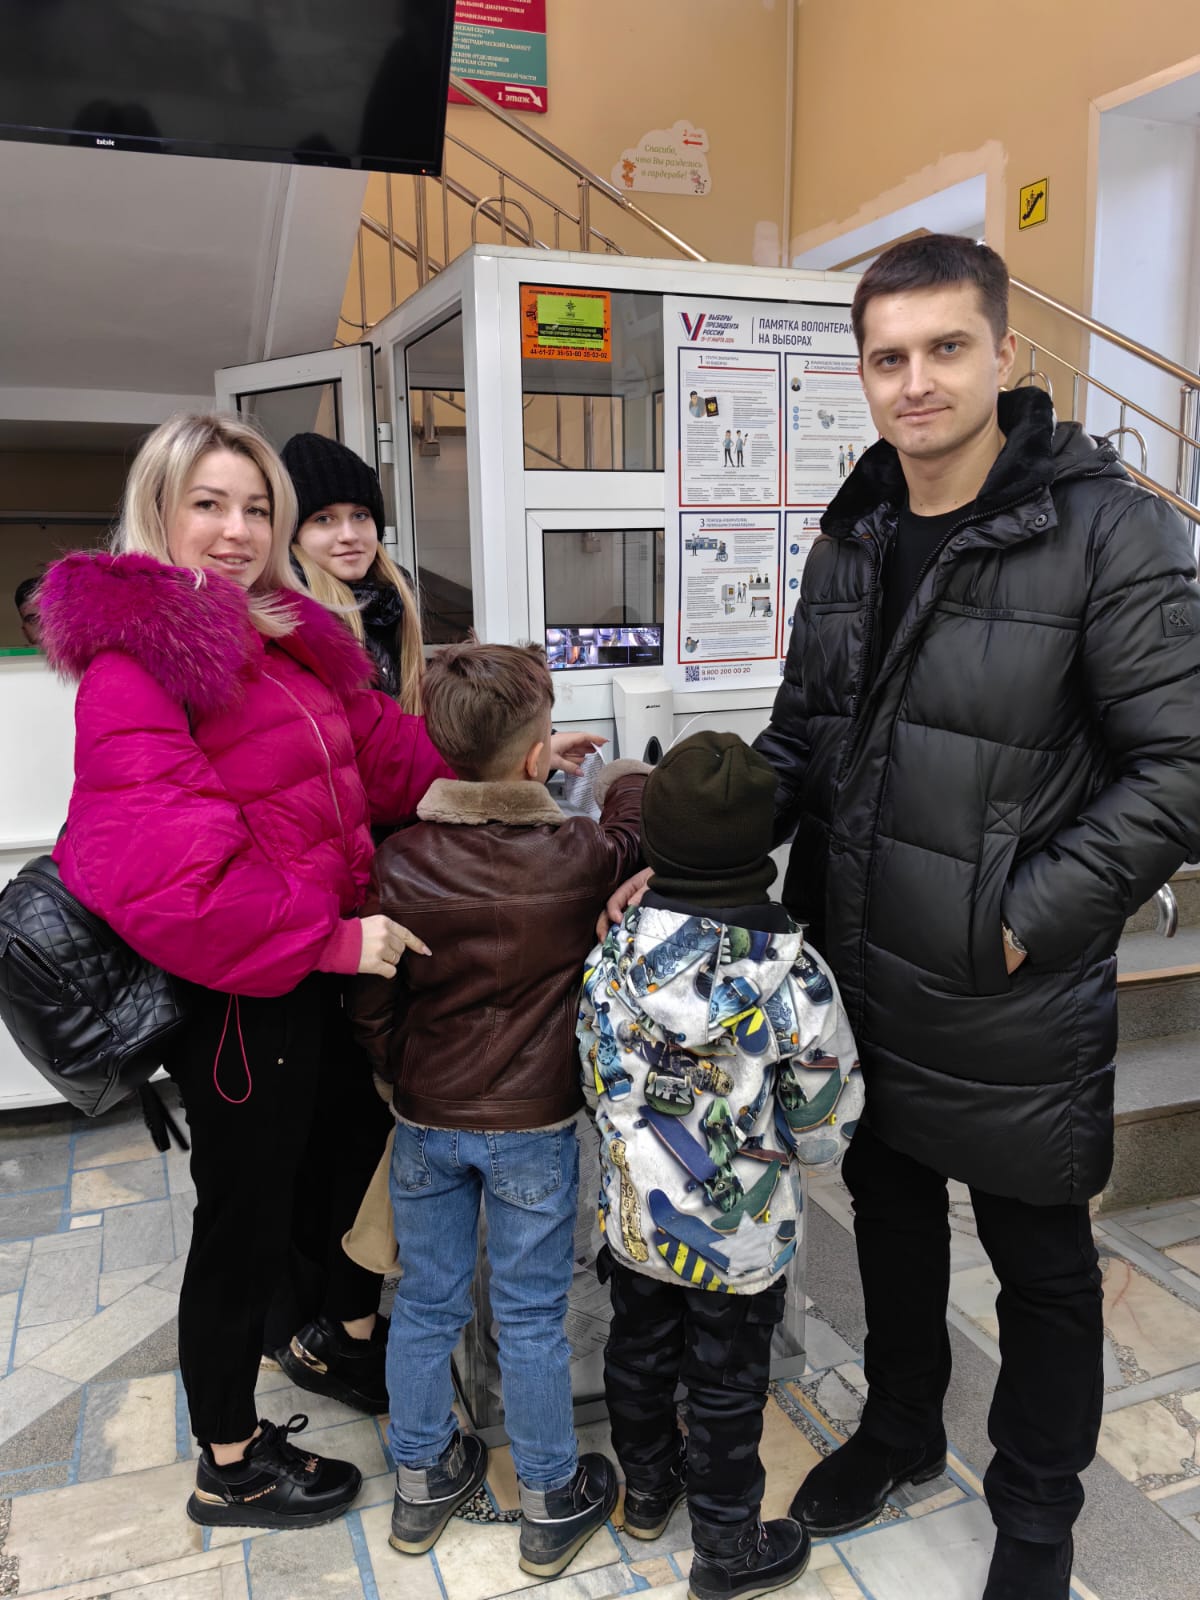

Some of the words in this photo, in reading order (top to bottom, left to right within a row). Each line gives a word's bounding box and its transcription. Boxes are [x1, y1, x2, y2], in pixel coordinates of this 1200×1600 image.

[497, 91, 503, 101] 1
[505, 95, 530, 104] этаж
[708, 313, 733, 322] ВЫБОРЫ
[704, 321, 740, 330] ПРЕЗИДЕНТА
[758, 318, 799, 331] ПАМЯТКА
[702, 329, 725, 337] РОССИИ
[758, 333, 770, 345] НА
[772, 334, 812, 346] ВЫБОРАХ
[804, 360, 810, 370] 2
[700, 518, 705, 528] 3
